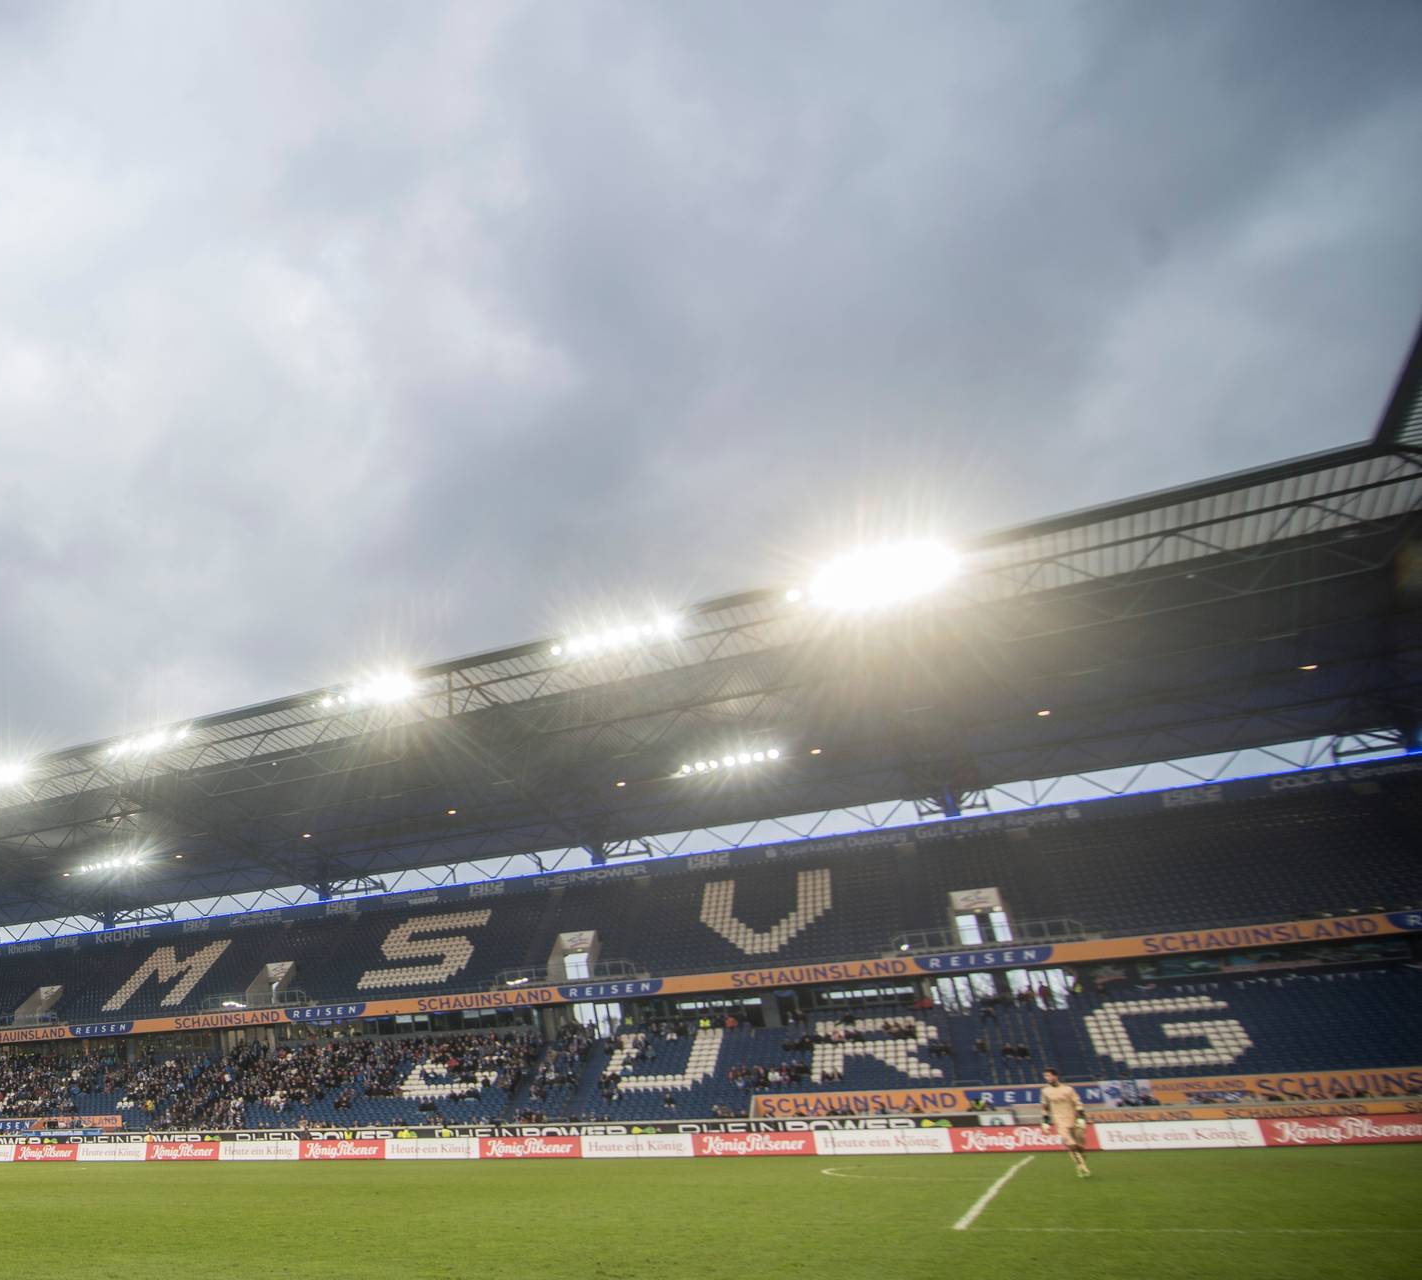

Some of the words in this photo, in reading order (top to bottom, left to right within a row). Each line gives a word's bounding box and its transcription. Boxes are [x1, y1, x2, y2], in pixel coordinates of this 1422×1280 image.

[533, 864, 648, 888] RHEINPOWER
[1143, 918, 1380, 953] SCHAUINSLAND
[731, 960, 908, 988] SCHAUINSLAND
[929, 950, 1037, 969] REISEN
[418, 989, 552, 1011] SCHAUINSLAND
[569, 982, 651, 997] REISEN
[174, 1011, 280, 1029] SCHAUINSLAND
[293, 1006, 356, 1019] REISEN
[75, 1023, 127, 1035] REISEN
[762, 1093, 958, 1115] SCHAUINSLAND
[981, 1087, 1101, 1104] REIN
[824, 1137, 862, 1148] Heute
[870, 1137, 891, 1147] ein
[894, 1135, 939, 1149] König
[961, 1129, 1017, 1151] König
[1107, 1129, 1158, 1143] Heute
[1164, 1129, 1189, 1141] ein
[1195, 1127, 1250, 1142] König
[1270, 1121, 1344, 1145] König
[18, 1142, 48, 1161] König
[44, 1141, 73, 1159] Pilsener
[153, 1144, 179, 1160] König
[177, 1143, 214, 1158] Pilsener
[305, 1142, 339, 1160] König
[337, 1140, 379, 1156] Pilsener
[391, 1144, 420, 1154] Heute
[422, 1145, 438, 1153] ein
[442, 1143, 473, 1155] König
[487, 1140, 524, 1158] König
[521, 1138, 573, 1155] Pilsener
[588, 1141, 618, 1152] Heute
[623, 1142, 644, 1151] ein
[647, 1140, 683, 1152] König
[703, 1136, 747, 1156] König
[744, 1133, 806, 1153] Pilsener
